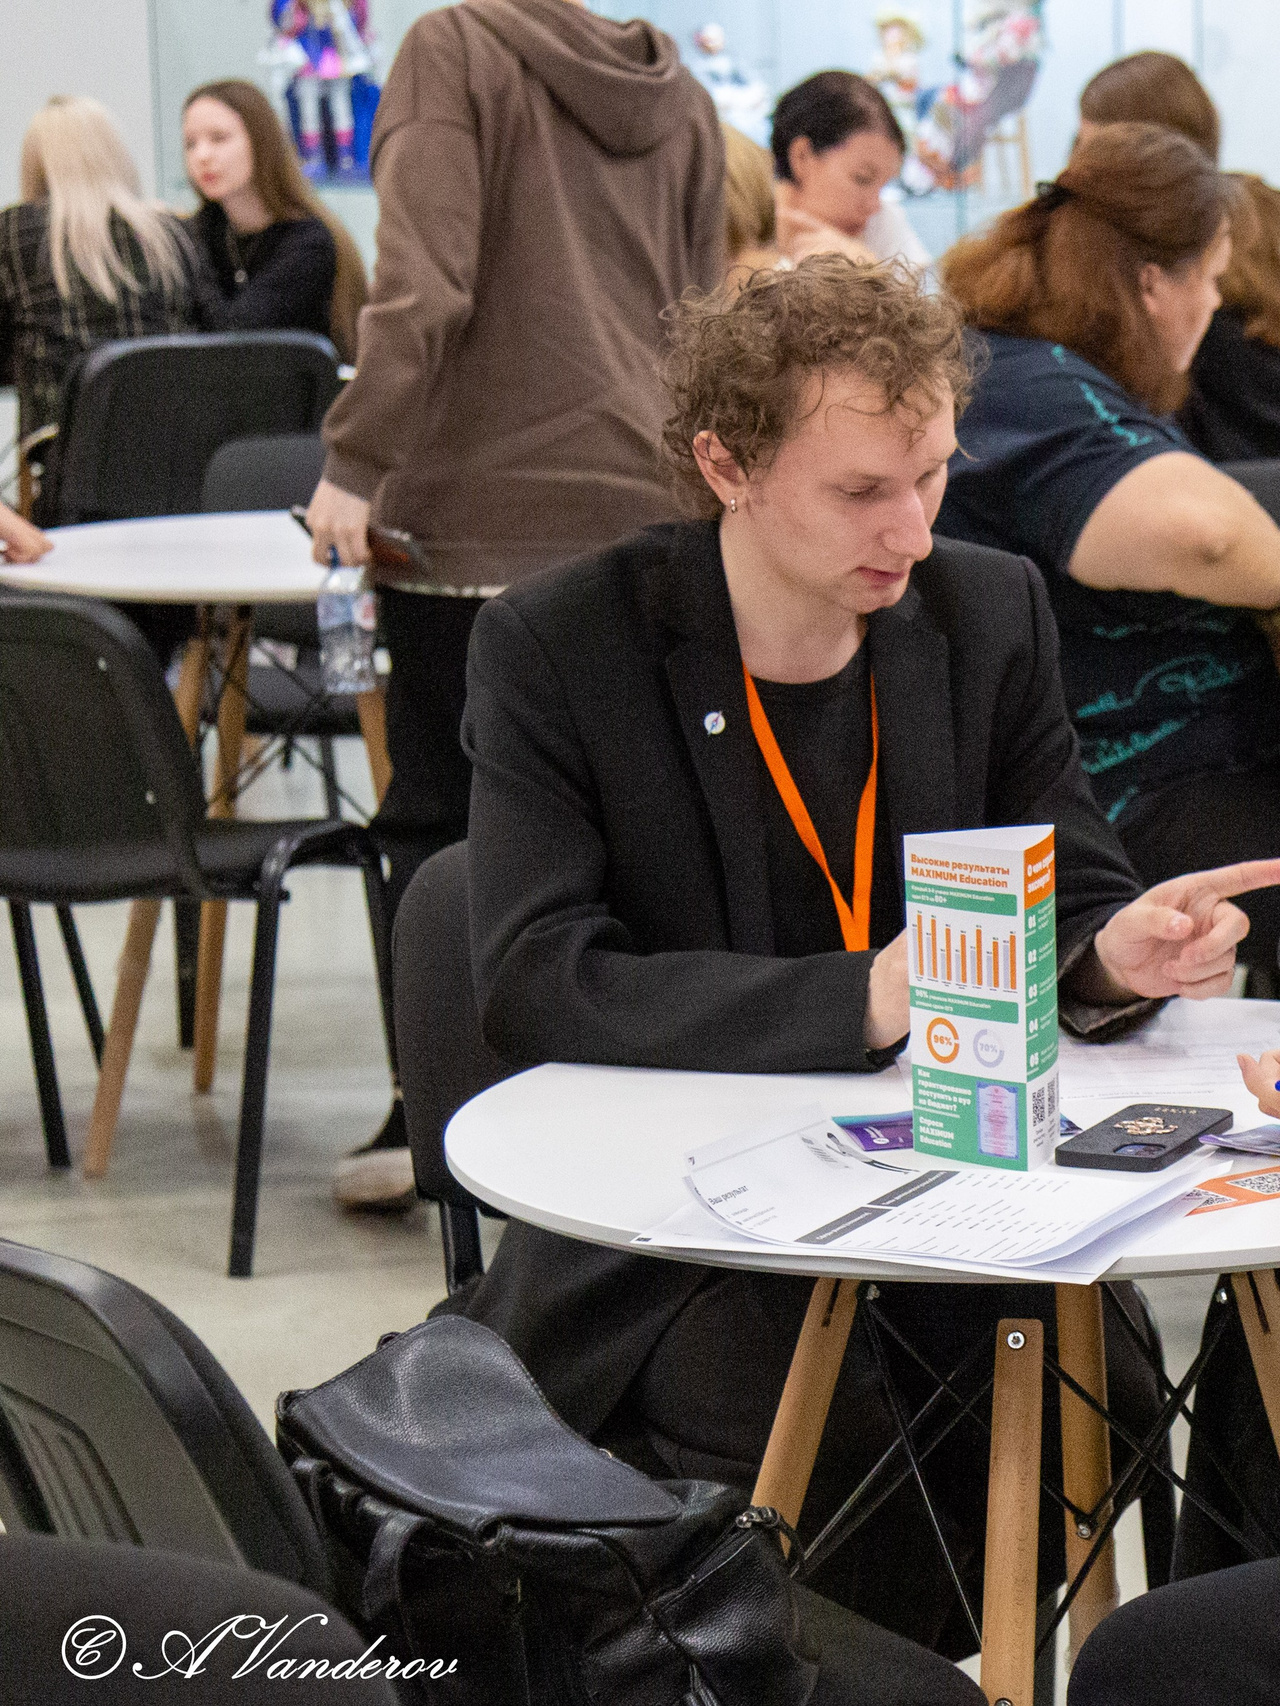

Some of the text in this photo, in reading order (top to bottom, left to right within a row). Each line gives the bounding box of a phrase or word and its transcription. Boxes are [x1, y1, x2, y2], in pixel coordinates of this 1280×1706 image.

[911, 853, 1010, 876] Высокие результаты
[911, 866, 1008, 888] MAXIMUM Education
[1028, 914, 1037, 929] 01
[1028, 949, 1037, 964] 02
[1028, 984, 1038, 999] 03
[1029, 1018, 1039, 1033] 04
[933, 1034, 952, 1046] 96%
[979, 1043, 998, 1053] 70%
[917, 1068, 931, 1078] Как
[918, 1089, 952, 1102] поступить
[927, 1099, 957, 1112] бюджет?
[919, 1117, 944, 1128] Спроси
[919, 1126, 954, 1140] MAXIMUM
[919, 1135, 952, 1148] Education
[707, 1196, 723, 1206] Ваш
